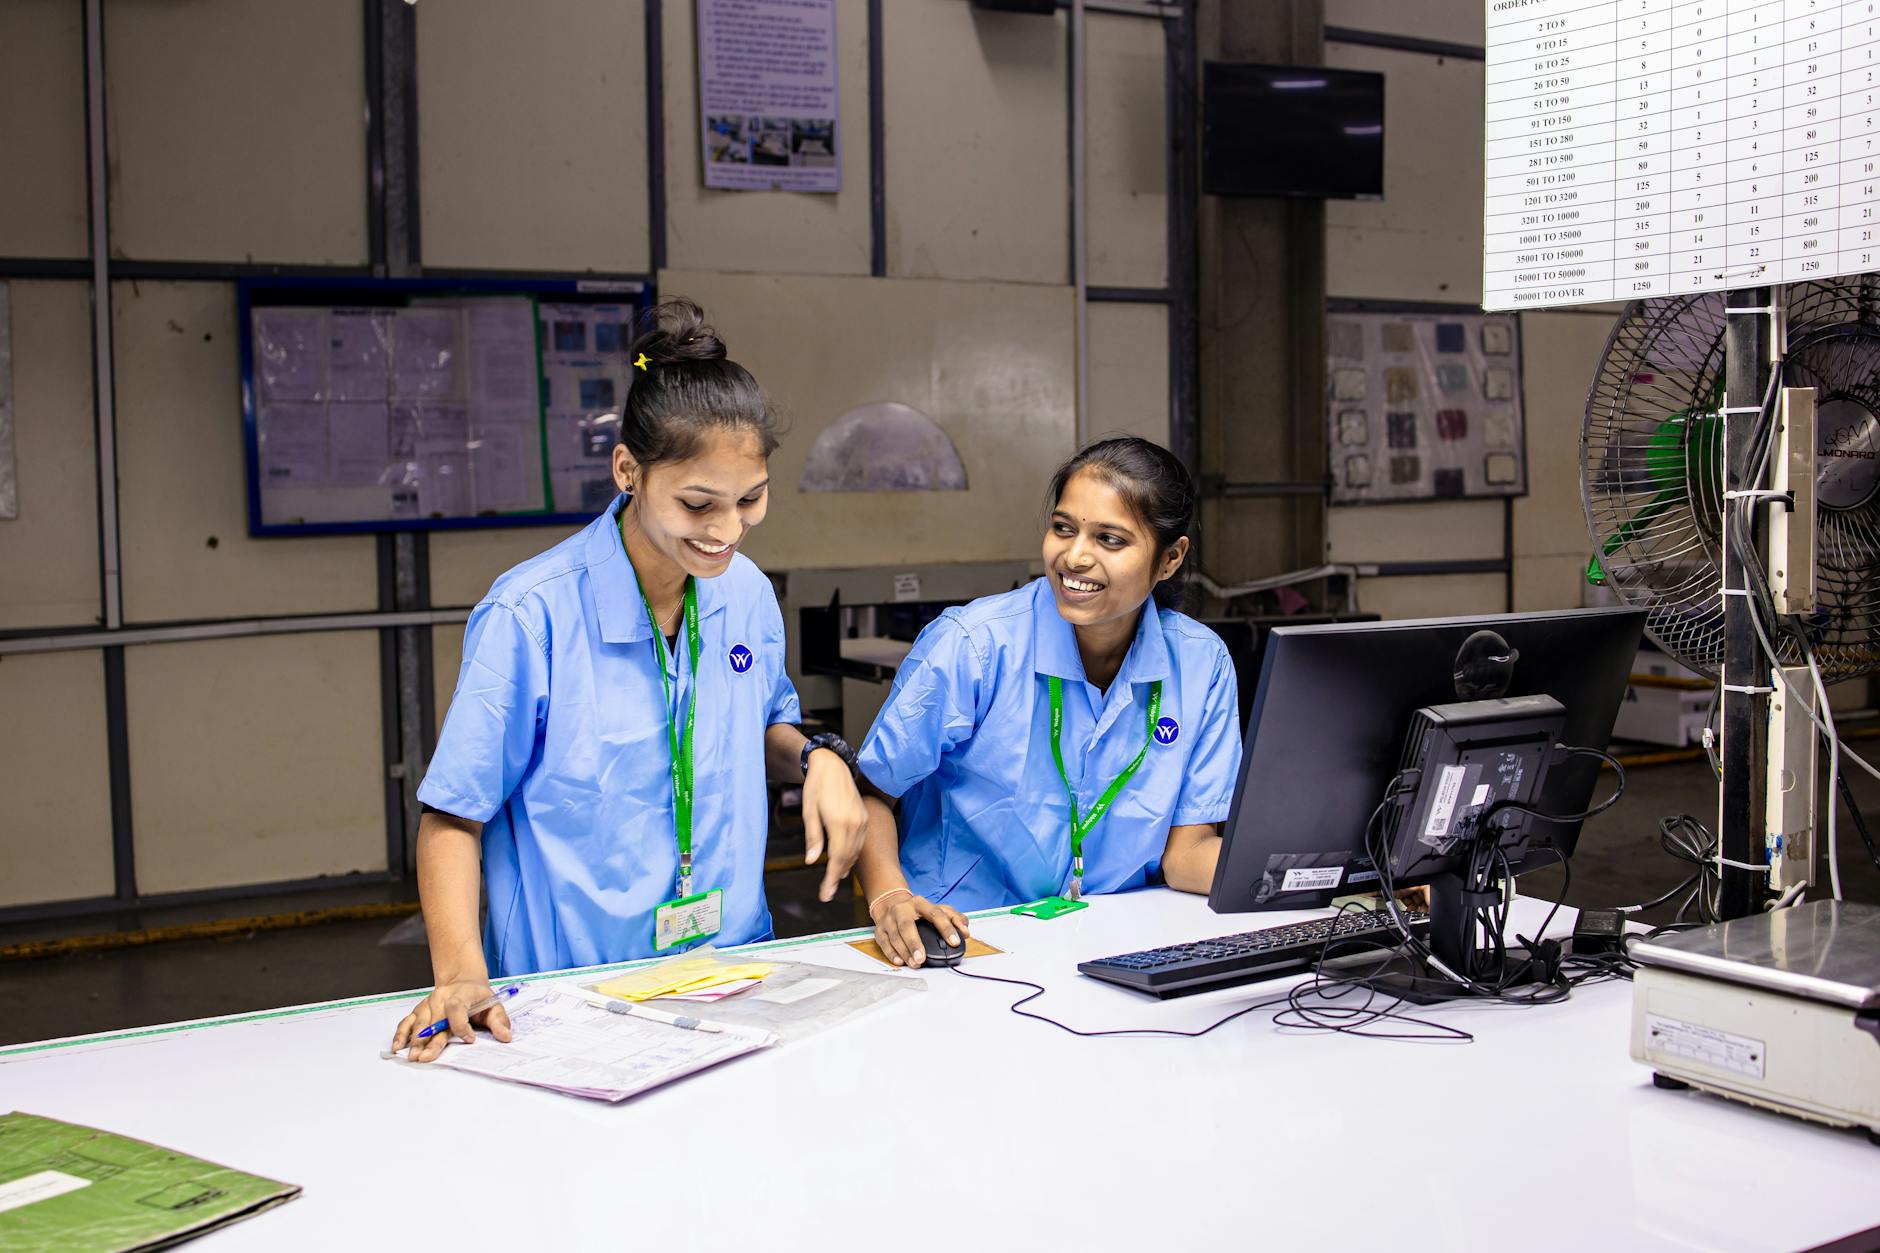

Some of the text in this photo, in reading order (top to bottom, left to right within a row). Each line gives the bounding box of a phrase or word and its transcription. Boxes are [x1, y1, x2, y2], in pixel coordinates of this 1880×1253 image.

[1493, 0, 1528, 11] ORDER
[1539, 23, 1543, 32] 2
[1546, 21, 1559, 30] TO
[1560, 19, 1565, 27] 8
[1534, 62, 1543, 71] 16
[1546, 59, 1558, 69] TO
[1560, 57, 1570, 66] 25
[1536, 43, 1541, 51] 9
[1543, 40, 1556, 50] TO
[1559, 38, 1568, 47] 15
[1531, 120, 1540, 129] 91
[1542, 117, 1556, 127] TO
[1558, 115, 1572, 125] 150
[1639, 101, 1649, 111] 20
[1807, 64, 1817, 75] 20
[1534, 100, 1542, 110] 51
[1544, 98, 1558, 108] TO
[1559, 96, 1570, 104] 90
[1640, 80, 1648, 90] 13
[1808, 42, 1817, 52] 13
[1534, 81, 1543, 90] 26
[1546, 79, 1558, 88] TO
[1560, 77, 1570, 86] 50
[1529, 158, 1542, 167] 281
[1544, 156, 1558, 165] TO
[1559, 153, 1574, 163] 500
[1638, 141, 1648, 151] 50
[1807, 108, 1817, 118] 50
[1530, 139, 1542, 148] 151
[1545, 137, 1558, 146] TO
[1560, 134, 1574, 144] 280
[1638, 121, 1648, 131] 32
[1807, 85, 1817, 96] 32
[1524, 196, 1541, 206] 1201
[1544, 194, 1557, 203] TO
[1559, 191, 1578, 202] 3200
[1636, 181, 1650, 191] 125
[1805, 151, 1819, 162] 125
[1526, 177, 1539, 187] 501
[1541, 175, 1555, 184] TO
[1558, 172, 1576, 183] 1200
[1638, 161, 1648, 171] 80
[1806, 129, 1817, 140] 80
[1519, 185, 1873, 244] 10001 TO 35000 315 10 11 315 14
[1521, 216, 1539, 226] 3201
[1541, 214, 1555, 223] TO
[1557, 210, 1580, 221] 10000
[1635, 201, 1650, 211] 200
[1804, 173, 1819, 184] 200
[1864, 162, 1874, 173] 10
[1514, 231, 1871, 283] 150001 TO 500000 800 21 22 800 21
[1516, 208, 1872, 264] 35001 TO 150000 500 14 15 500 21
[1513, 292, 1540, 302] 500001
[1543, 290, 1556, 299] TO
[1558, 288, 1585, 298] OVER
[1633, 281, 1651, 291] 1250
[1693, 275, 1702, 285] 21
[1801, 260, 1820, 272] 1250
[1862, 253, 1871, 264] 21
